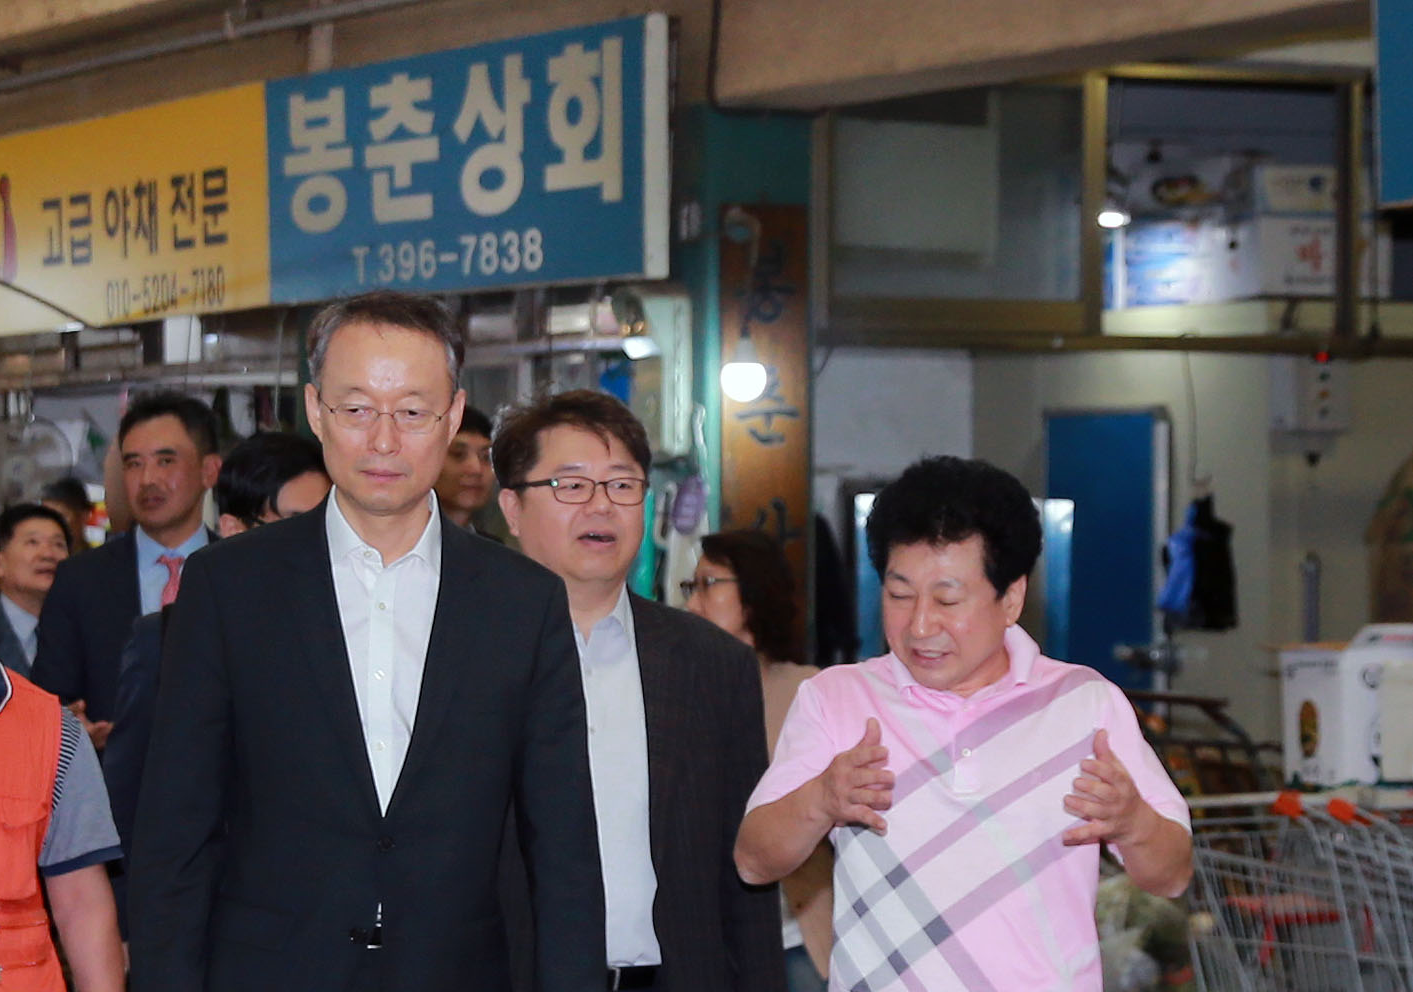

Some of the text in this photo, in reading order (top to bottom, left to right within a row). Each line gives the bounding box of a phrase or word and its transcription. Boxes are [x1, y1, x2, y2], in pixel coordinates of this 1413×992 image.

[283, 36, 624, 234] 봉춘상회
[42, 166, 229, 267] 고급 야채 전문
[352, 227, 545, 284] T.396-7838
